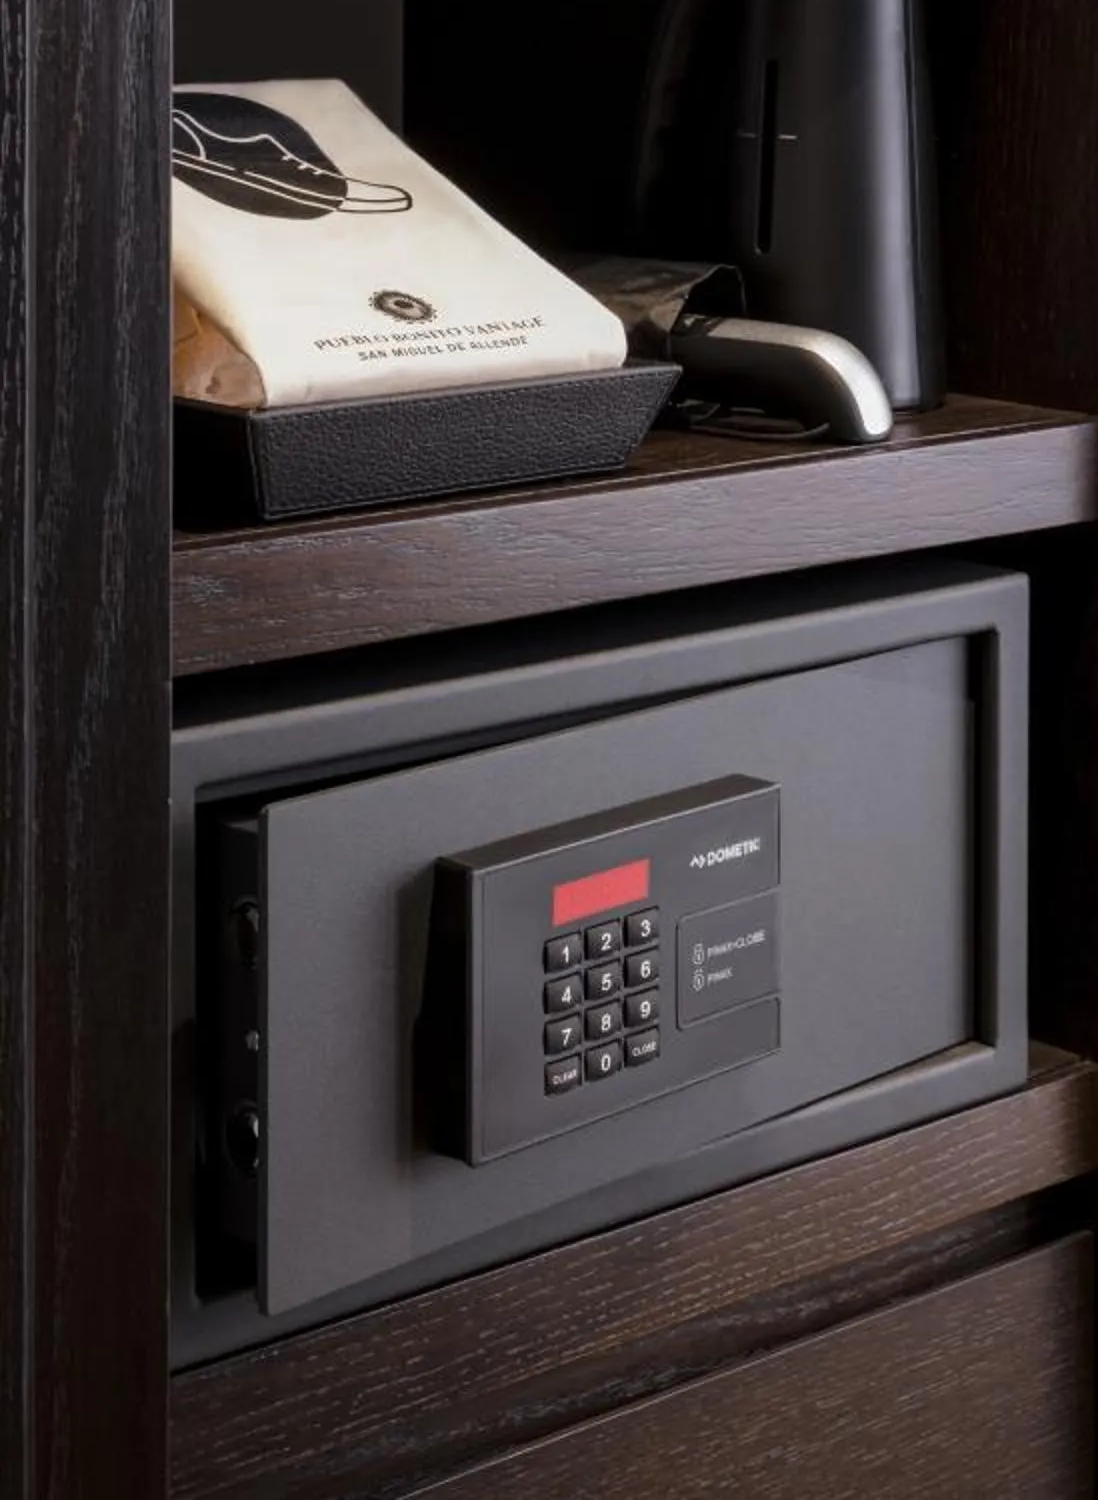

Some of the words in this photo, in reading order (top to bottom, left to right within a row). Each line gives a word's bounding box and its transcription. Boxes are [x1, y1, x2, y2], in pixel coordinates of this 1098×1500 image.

[313, 333, 389, 351] PUEBLO
[391, 326, 462, 343] BONITO
[462, 315, 545, 336] VANTAGE
[358, 350, 388, 362] SAN
[391, 344, 444, 358] MIGUEL
[446, 342, 466, 353] DE
[470, 335, 529, 350] ALLENDE
[707, 836, 761, 867] DOMETIC
[562, 945, 570, 963] 1
[601, 932, 612, 951] 2
[640, 919, 651, 937] 3
[561, 985, 572, 1003] 4
[601, 972, 612, 991] 5
[640, 960, 651, 979] 6
[561, 1027, 572, 1046] 7
[601, 1013, 612, 1032] 8
[640, 1000, 651, 1019] 9
[601, 1054, 612, 1072] 0
